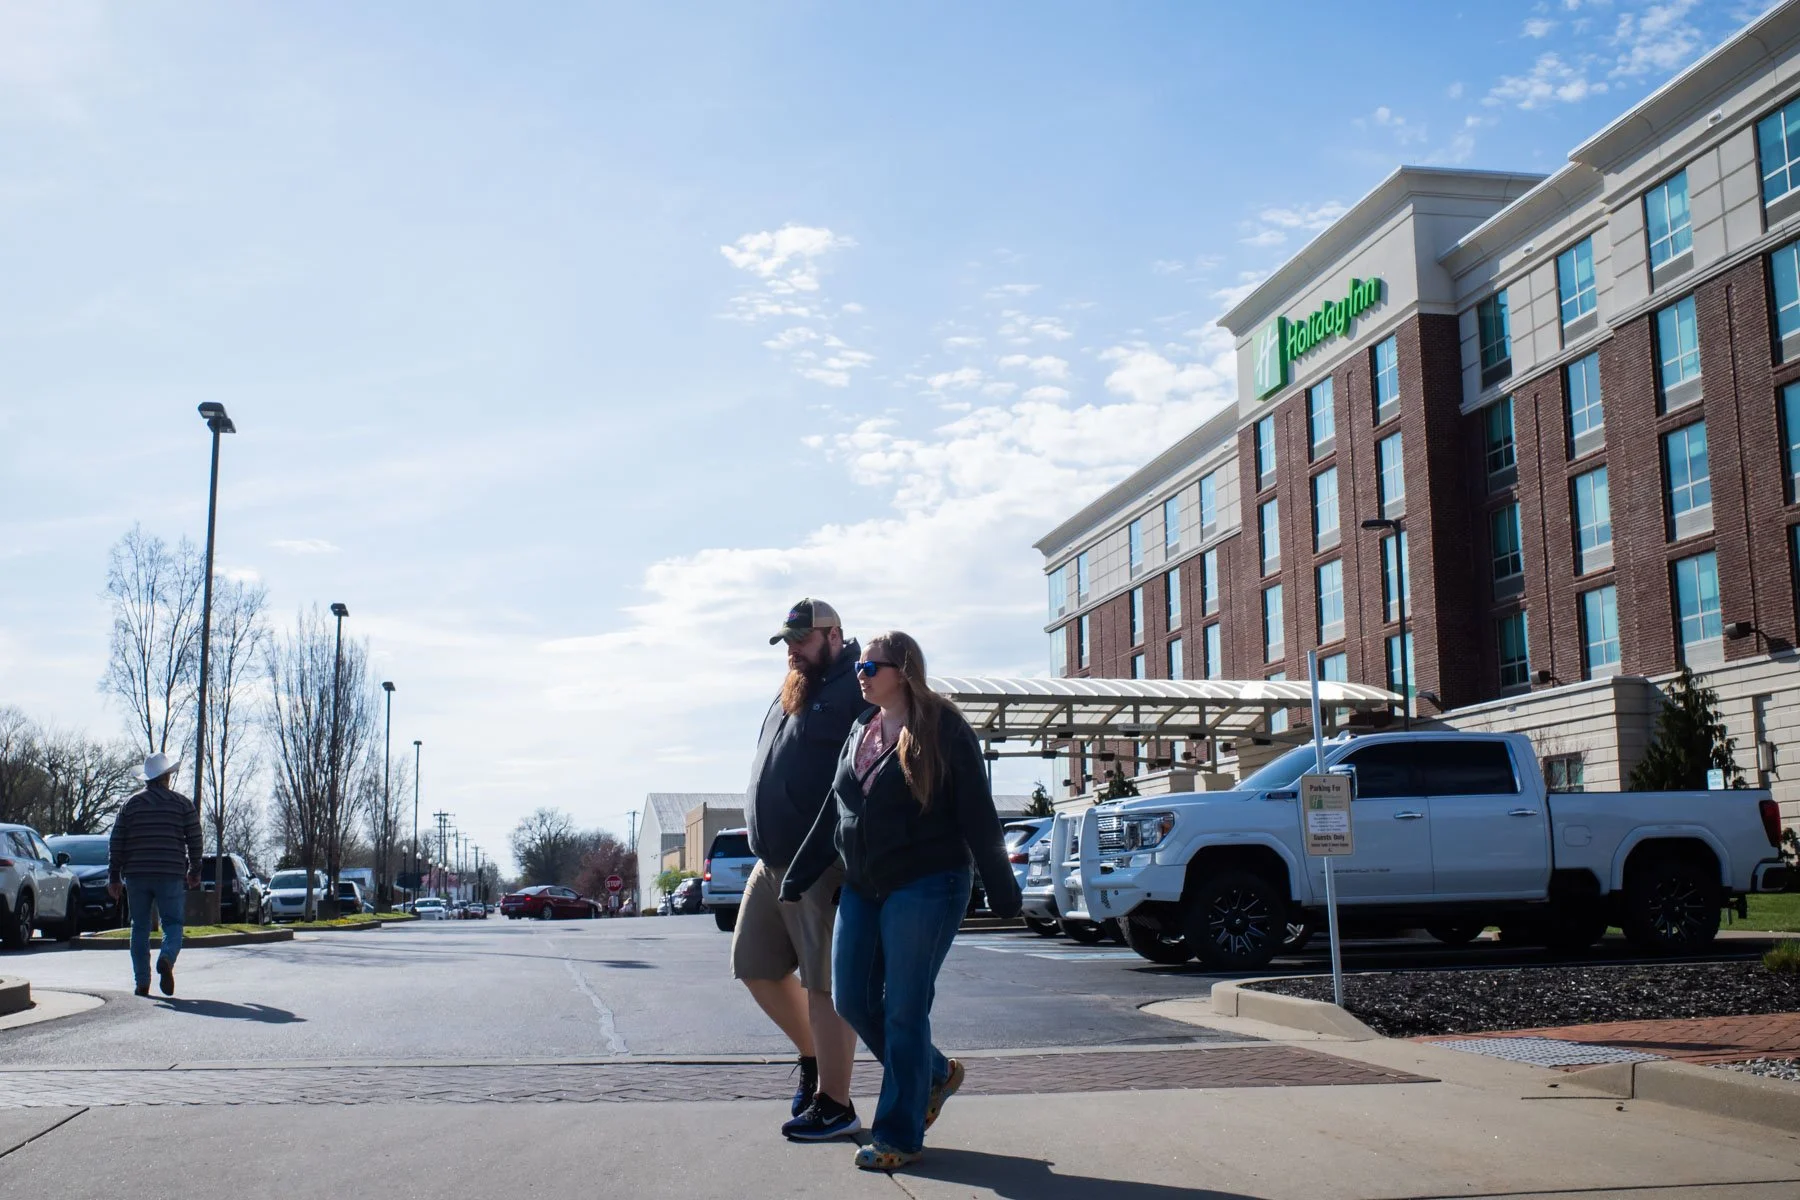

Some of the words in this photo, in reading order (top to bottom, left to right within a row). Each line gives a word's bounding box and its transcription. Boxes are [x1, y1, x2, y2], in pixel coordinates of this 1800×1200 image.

[1286, 297, 1351, 361] Holiday
[1348, 277, 1381, 318] Inn
[1310, 784, 1331, 793] Parking
[1332, 784, 1341, 792] For
[1333, 834, 1345, 842] Only
